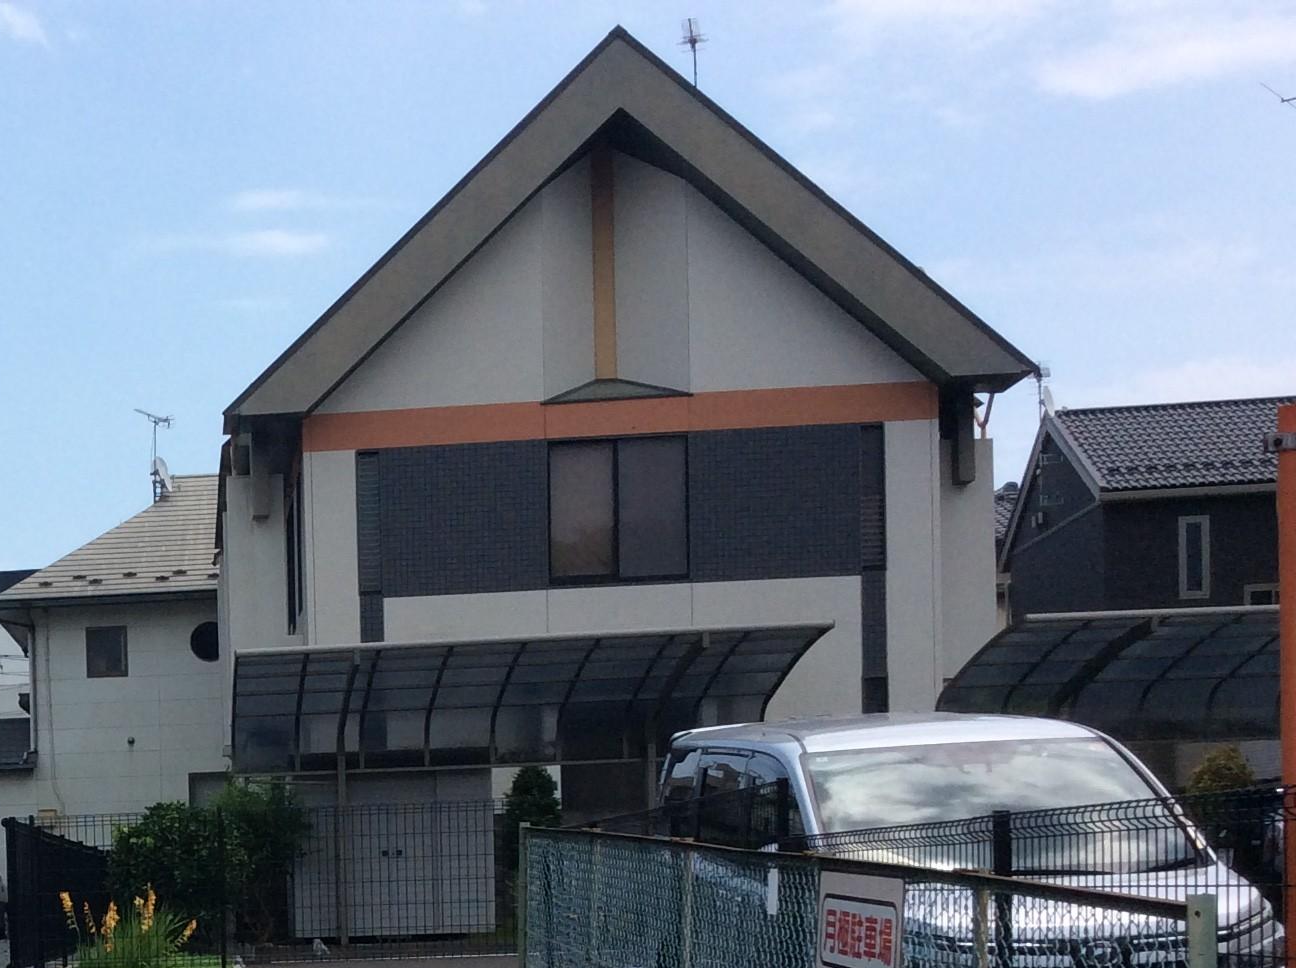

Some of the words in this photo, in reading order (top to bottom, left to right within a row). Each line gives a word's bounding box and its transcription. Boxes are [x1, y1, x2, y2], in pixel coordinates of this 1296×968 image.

[825, 909, 892, 966] 月極駐車場
